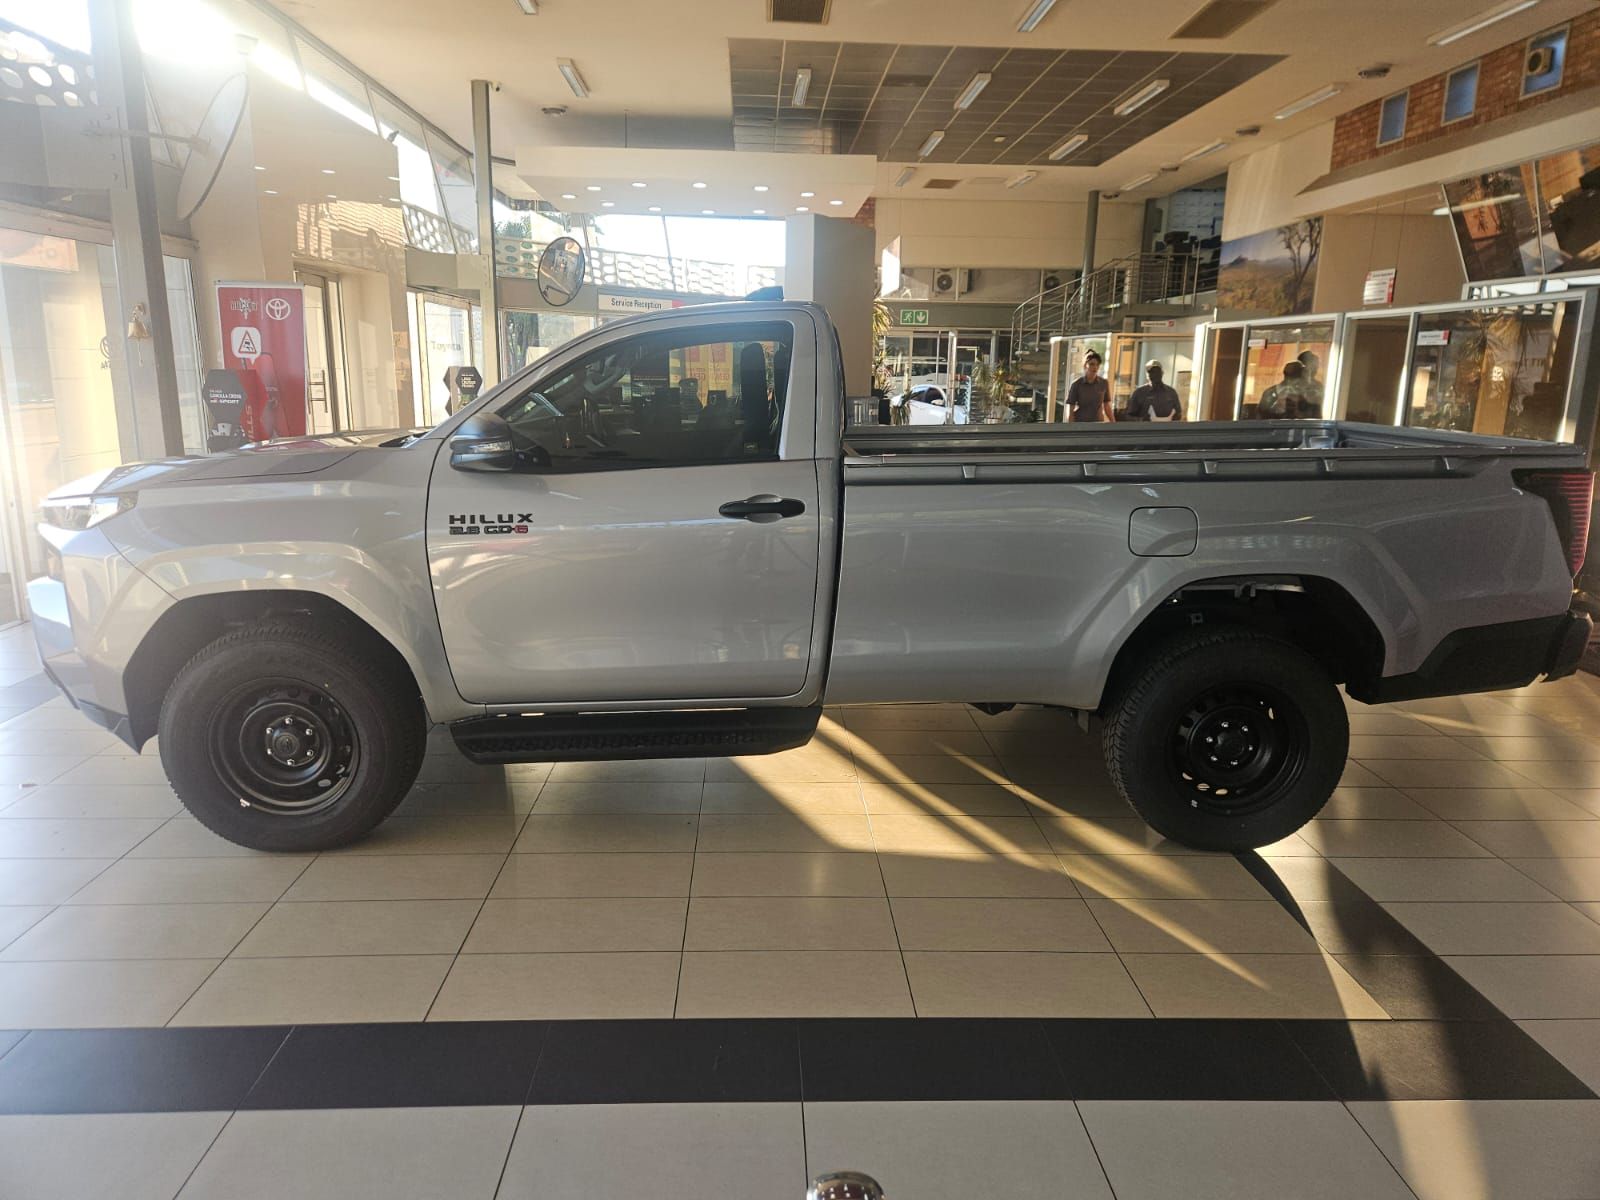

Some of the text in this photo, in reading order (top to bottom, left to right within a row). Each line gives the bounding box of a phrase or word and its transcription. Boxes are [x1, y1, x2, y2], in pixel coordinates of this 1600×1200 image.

[611, 297, 662, 310] Service Reception
[449, 514, 534, 524] HILUX
[449, 525, 529, 535] 2.8 GD-6
